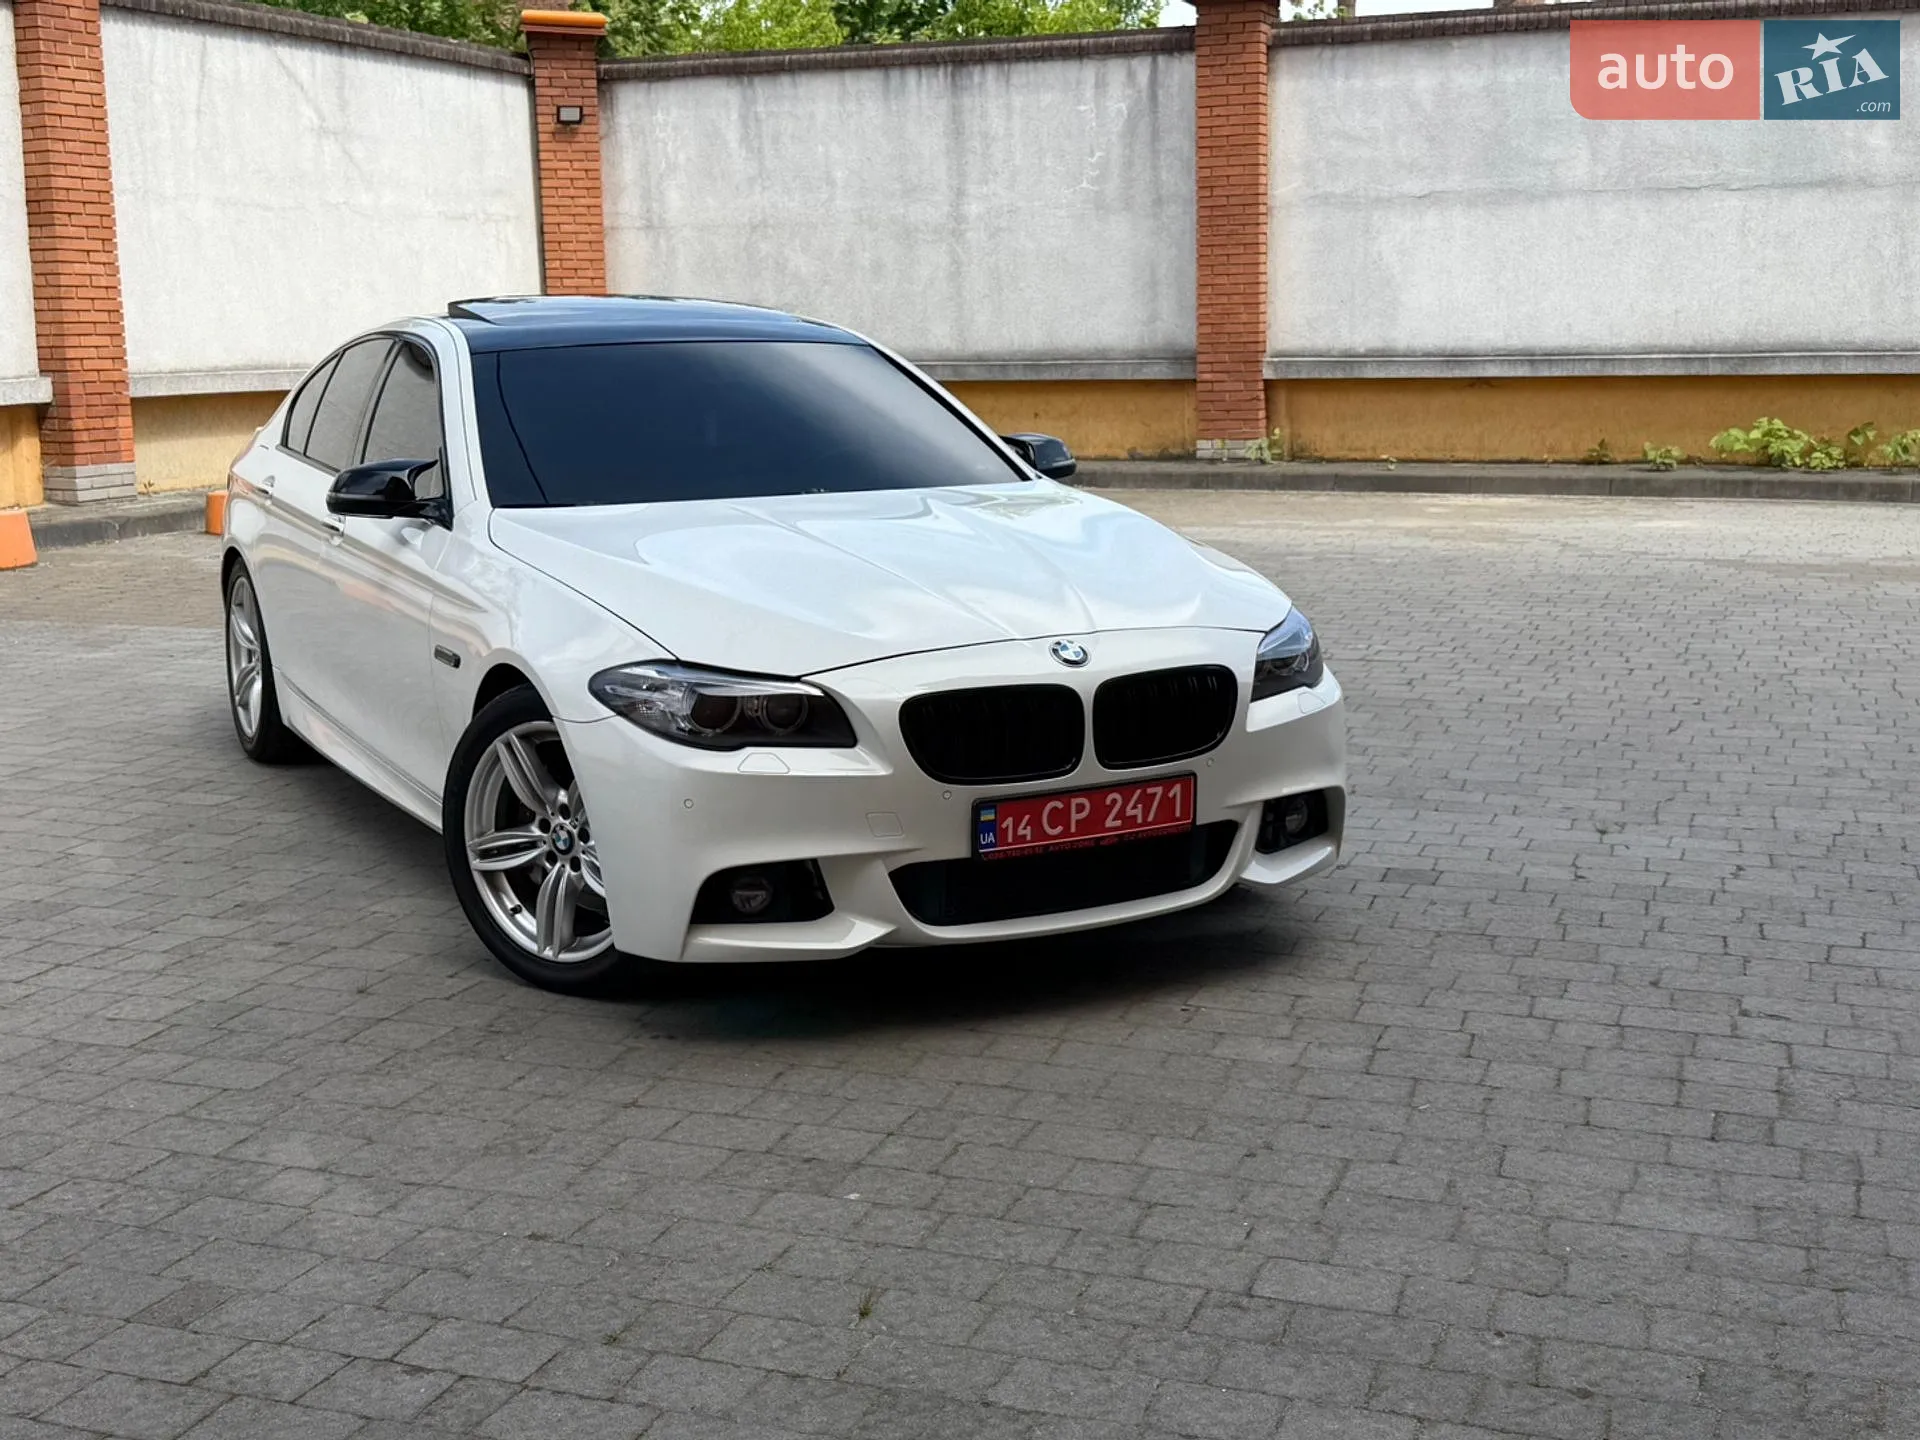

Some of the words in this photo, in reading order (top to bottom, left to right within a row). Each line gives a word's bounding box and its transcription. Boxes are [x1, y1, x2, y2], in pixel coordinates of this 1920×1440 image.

[1001, 814, 1032, 843] 14
[1041, 797, 1091, 836] CP
[1104, 783, 1183, 829] 2471
[980, 832, 996, 845] UA
